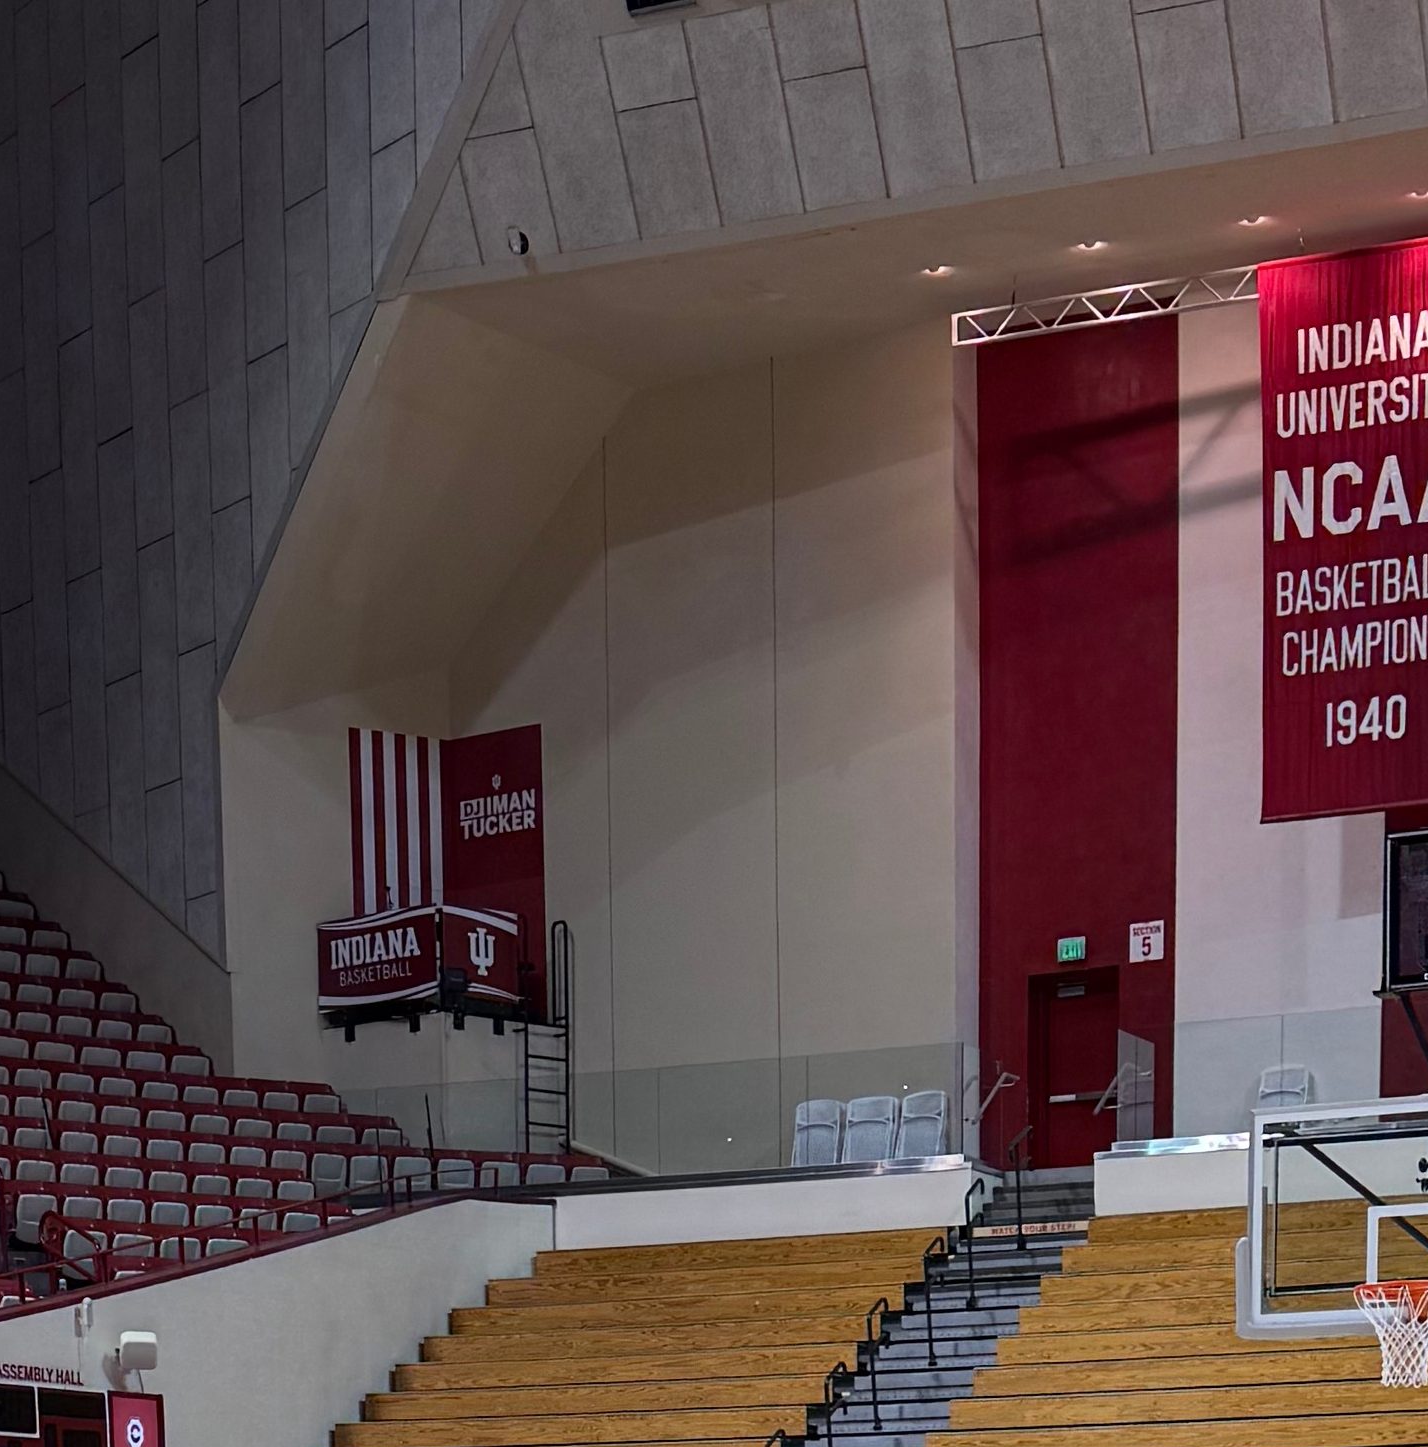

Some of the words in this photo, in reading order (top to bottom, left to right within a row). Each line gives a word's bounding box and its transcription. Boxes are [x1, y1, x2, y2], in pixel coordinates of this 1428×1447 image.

[1326, 695, 1406, 747] 1940
[460, 798, 484, 820] DJ
[487, 788, 536, 814] IMAN
[460, 810, 535, 840] TUCKER
[330, 927, 421, 970] INDIANA
[1142, 936, 1152, 956] 5
[339, 961, 412, 987] BASKETBALL
[56, 1369, 84, 1387] HALL
